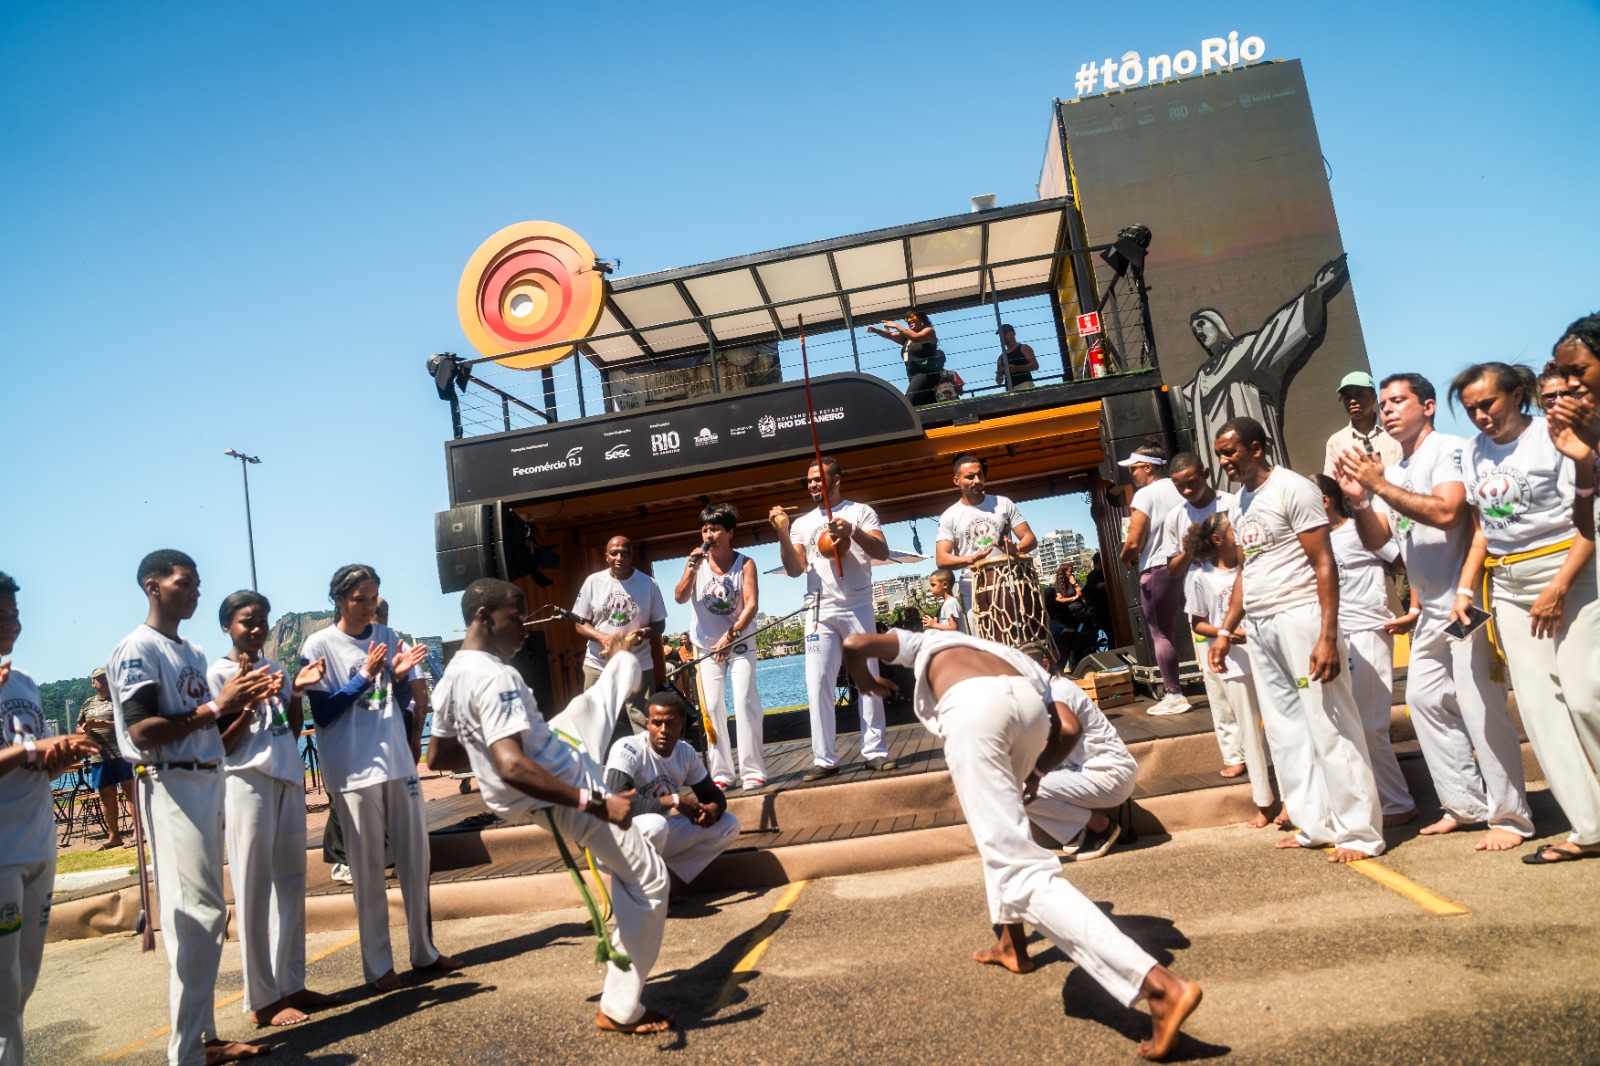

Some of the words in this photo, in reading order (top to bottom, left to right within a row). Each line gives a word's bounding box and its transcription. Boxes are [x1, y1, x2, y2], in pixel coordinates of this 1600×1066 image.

[777, 419, 793, 430] RIO
[794, 418, 807, 427] DE
[808, 411, 845, 425] JANEIRO
[650, 430, 680, 452] RIO
[512, 461, 567, 477] Fecomércio
[568, 456, 582, 467] RJ
[1490, 465, 1529, 496] CULTURAL
